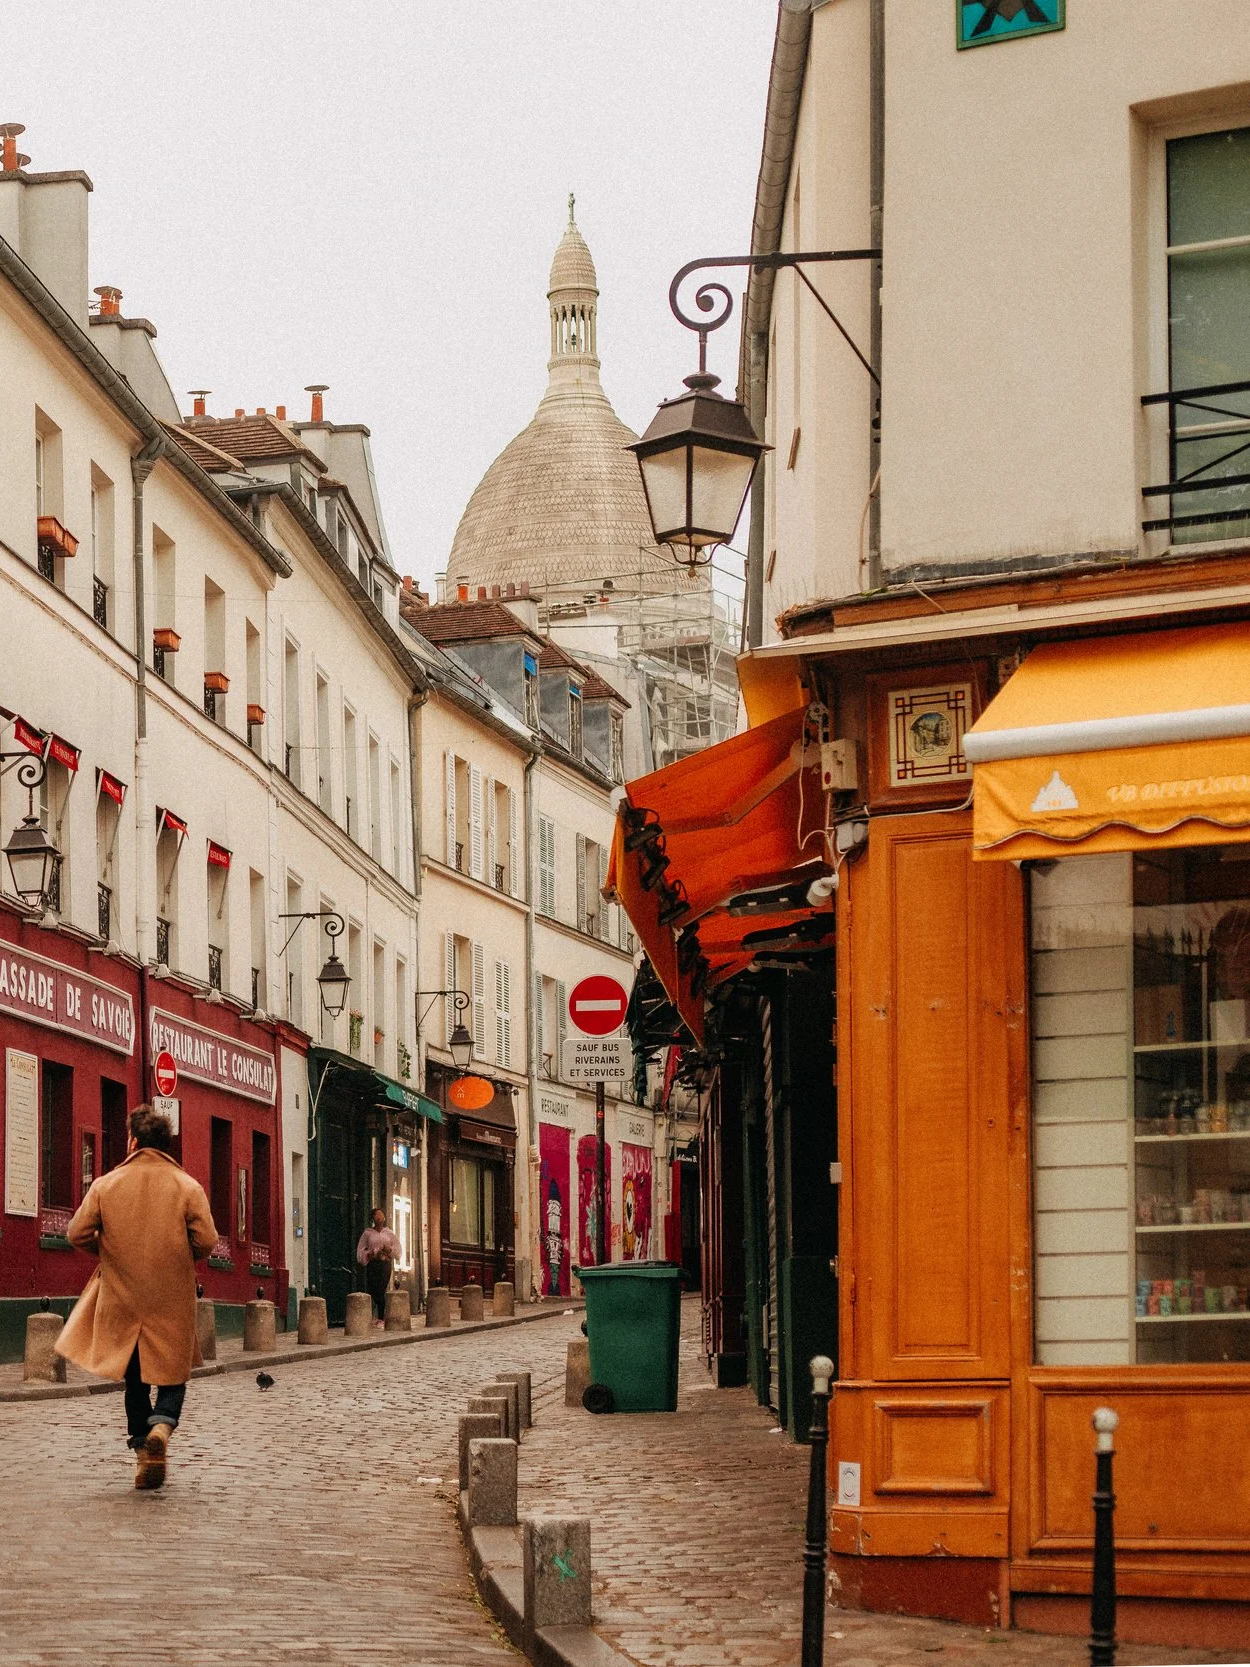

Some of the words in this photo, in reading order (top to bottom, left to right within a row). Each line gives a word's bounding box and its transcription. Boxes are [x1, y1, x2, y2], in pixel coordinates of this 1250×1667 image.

[66, 983, 81, 1021] DE
[92, 993, 130, 1041] SAVOIE
[576, 1043, 598, 1052] SAUF
[602, 1043, 619, 1052] BUS
[152, 1022, 214, 1071] RESTAURANT
[217, 1047, 228, 1077] LE
[232, 1053, 272, 1093] CONSULAT
[575, 1056, 620, 1064] RIVERAINS
[570, 1069, 580, 1077] ET
[584, 1068, 625, 1077] SERVICES
[160, 1100, 173, 1110] SAUF
[541, 1098, 569, 1118] RESTAURANT
[629, 1121, 645, 1138] GALERIE
